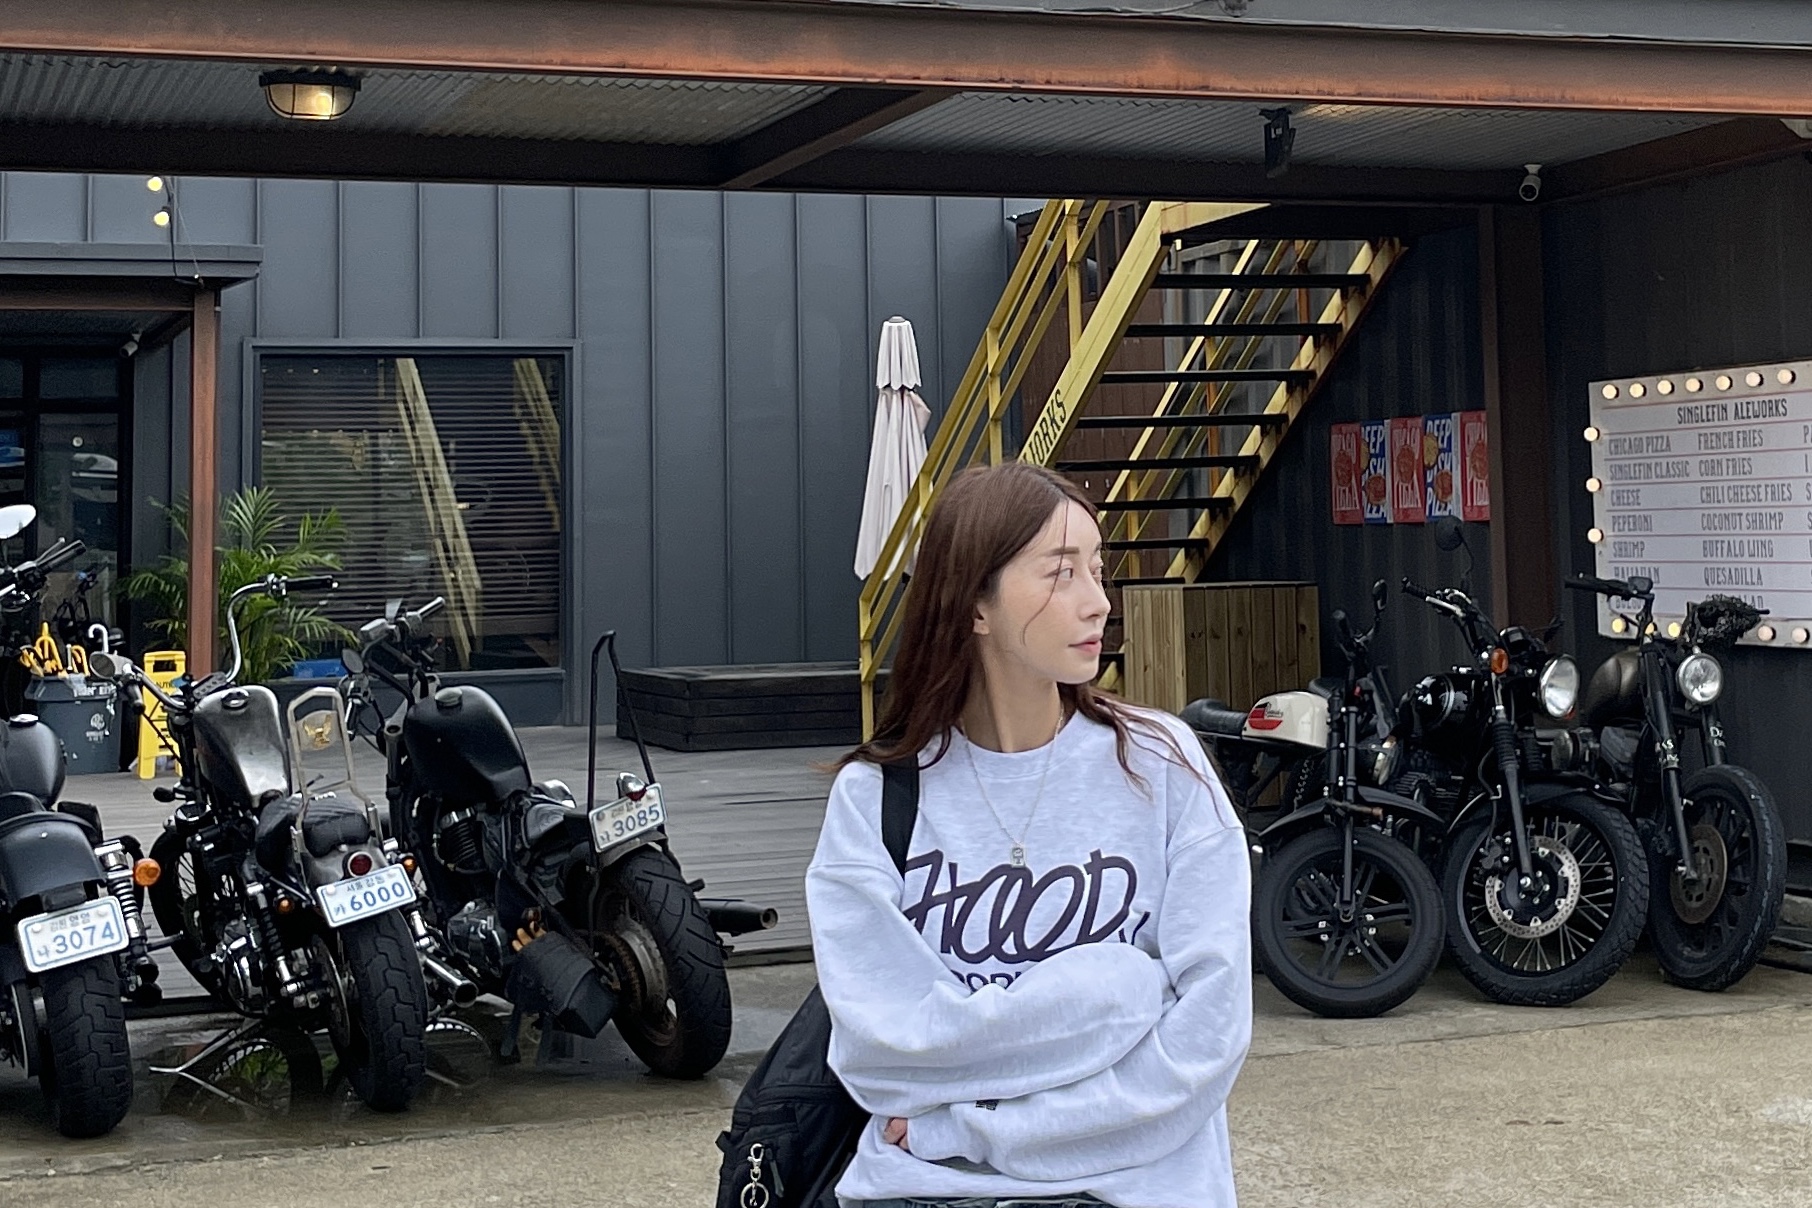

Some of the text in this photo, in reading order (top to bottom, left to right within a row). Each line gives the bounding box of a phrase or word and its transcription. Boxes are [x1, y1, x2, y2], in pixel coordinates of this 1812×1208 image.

[1677, 398, 1788, 425] SINGLEFIN ALEWORKS
[1608, 435, 1672, 456] CHICAGO PIZZA
[1698, 429, 1764, 450] FRENCH FRIES
[1609, 460, 1690, 481] SINGLEFIN CLASSIC
[1698, 457, 1753, 477] CORN FRIES
[1610, 489, 1641, 507] CHEESE
[1700, 483, 1793, 504] CHILI CHEESE FRIES
[1612, 514, 1653, 532] PEPERONI
[1701, 512, 1784, 531] COCONUT SHRIMP
[1613, 541, 1645, 558] SHRIMP
[1702, 539, 1774, 558] BUFFALO WING
[1703, 567, 1764, 586] QUESADILLA
[613, 804, 660, 838] 3085
[350, 881, 406, 912] 6000
[53, 921, 115, 954] 3074
